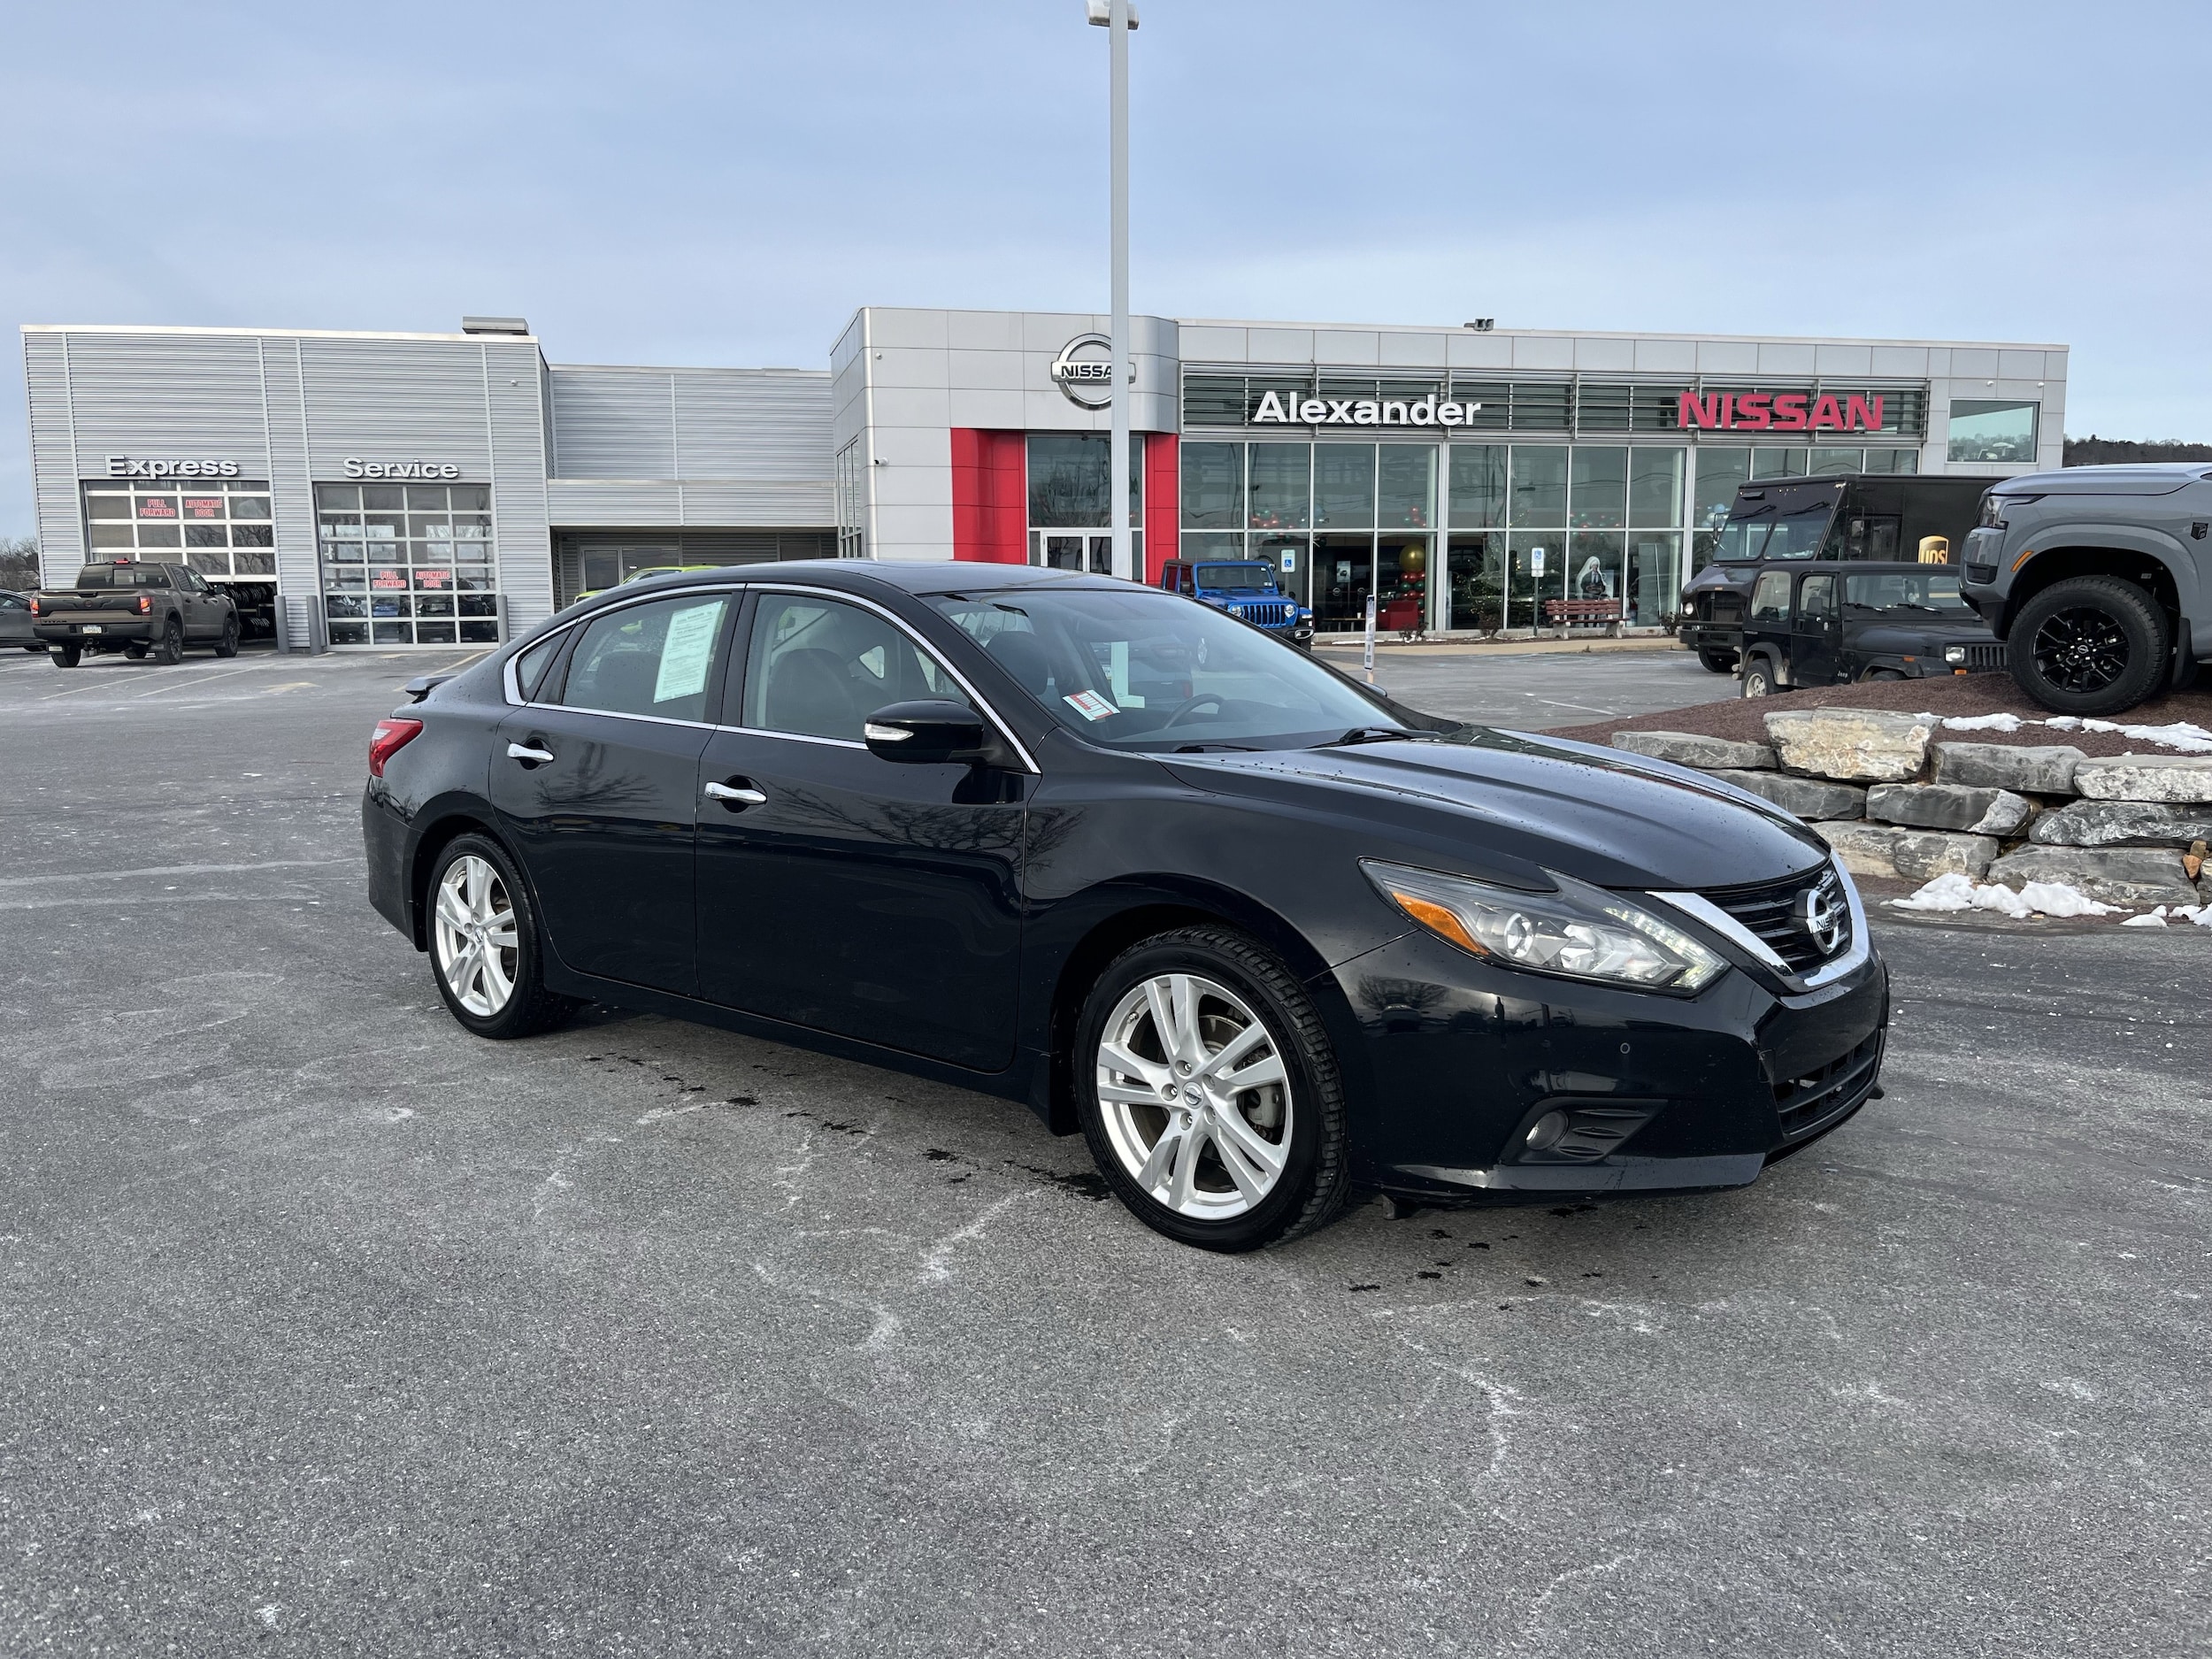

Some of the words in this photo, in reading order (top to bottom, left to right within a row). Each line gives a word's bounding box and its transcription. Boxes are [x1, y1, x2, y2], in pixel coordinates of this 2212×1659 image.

[1061, 365, 1112, 379] NISSA
[1253, 390, 1482, 426] Alexander
[1678, 391, 1884, 431] NISSAN
[104, 454, 239, 480] Express
[342, 457, 459, 479] Service
[147, 498, 167, 508] PULL
[185, 499, 223, 509] AUTOMATIC
[140, 508, 176, 518] FORWARD
[194, 509, 215, 518] DOOR
[380, 571, 399, 580] PULL
[415, 571, 450, 580] AUTOMATIC
[373, 580, 407, 588] FORWARD
[423, 580, 442, 588] DOOR
